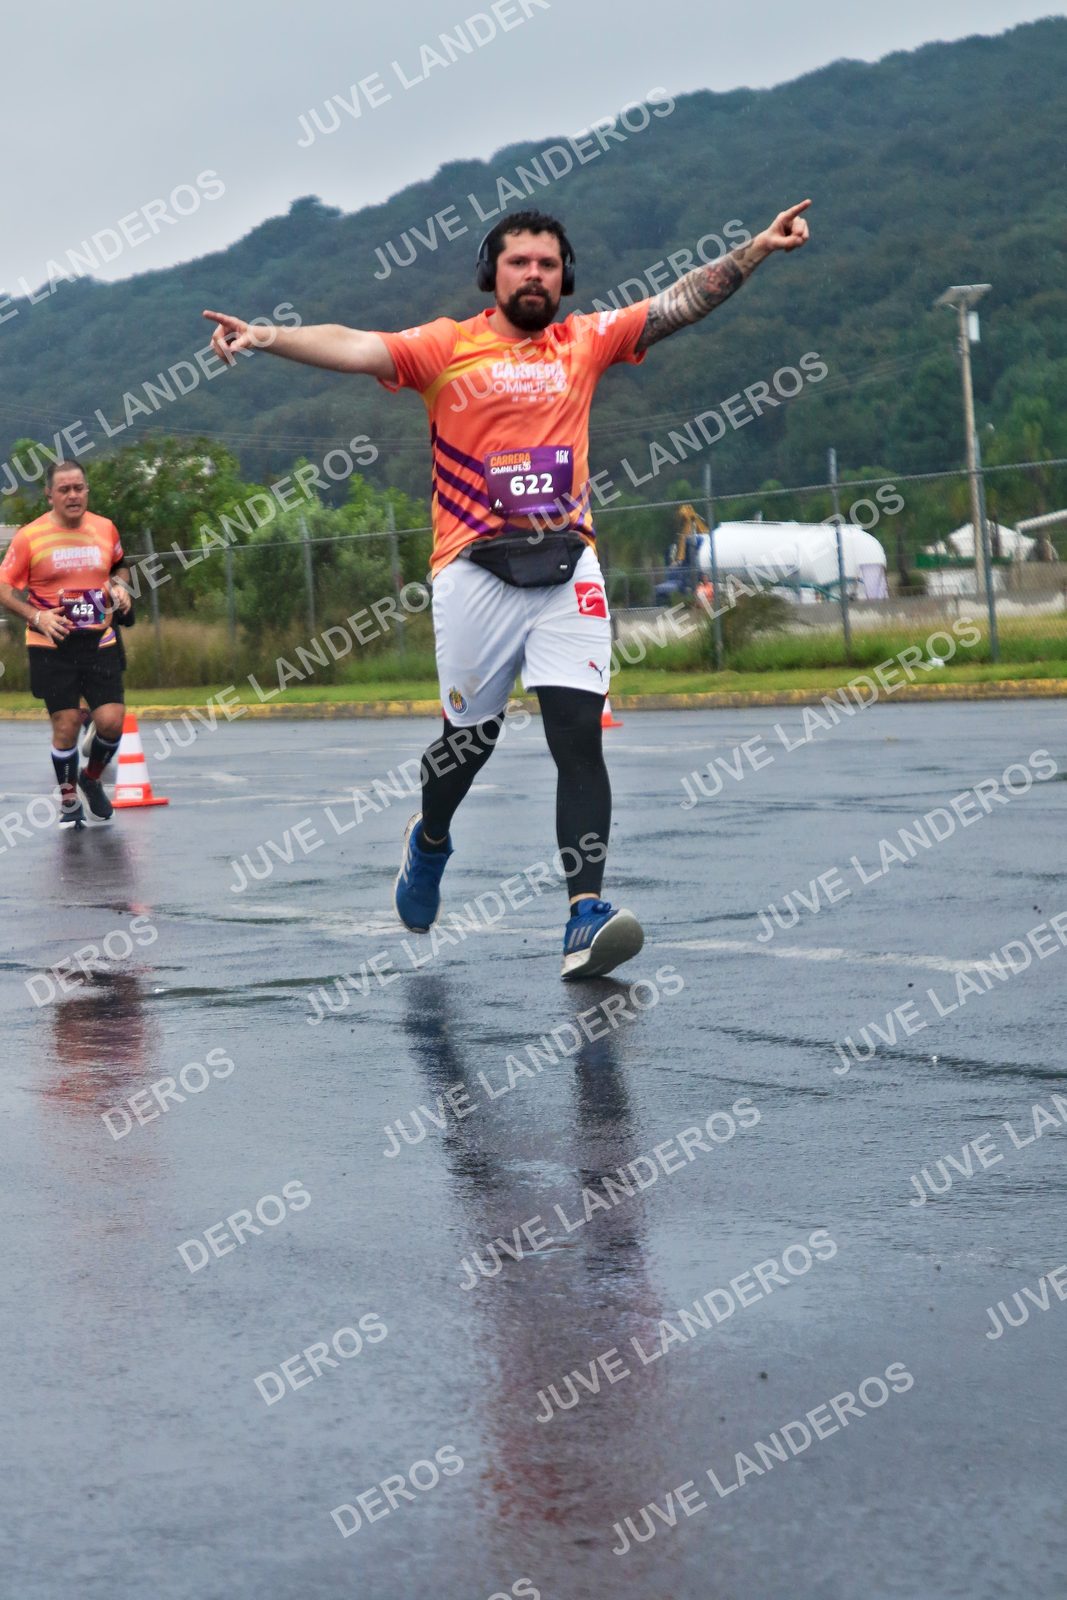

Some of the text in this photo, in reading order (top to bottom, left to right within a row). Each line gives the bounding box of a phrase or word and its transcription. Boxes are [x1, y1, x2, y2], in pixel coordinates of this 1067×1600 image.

[492, 360, 566, 379] CARRERA
[490, 452, 531, 467] CARRERA
[490, 463, 522, 475] OMNILIFE
[510, 473, 554, 496] 622
[72, 604, 94, 616] 452
